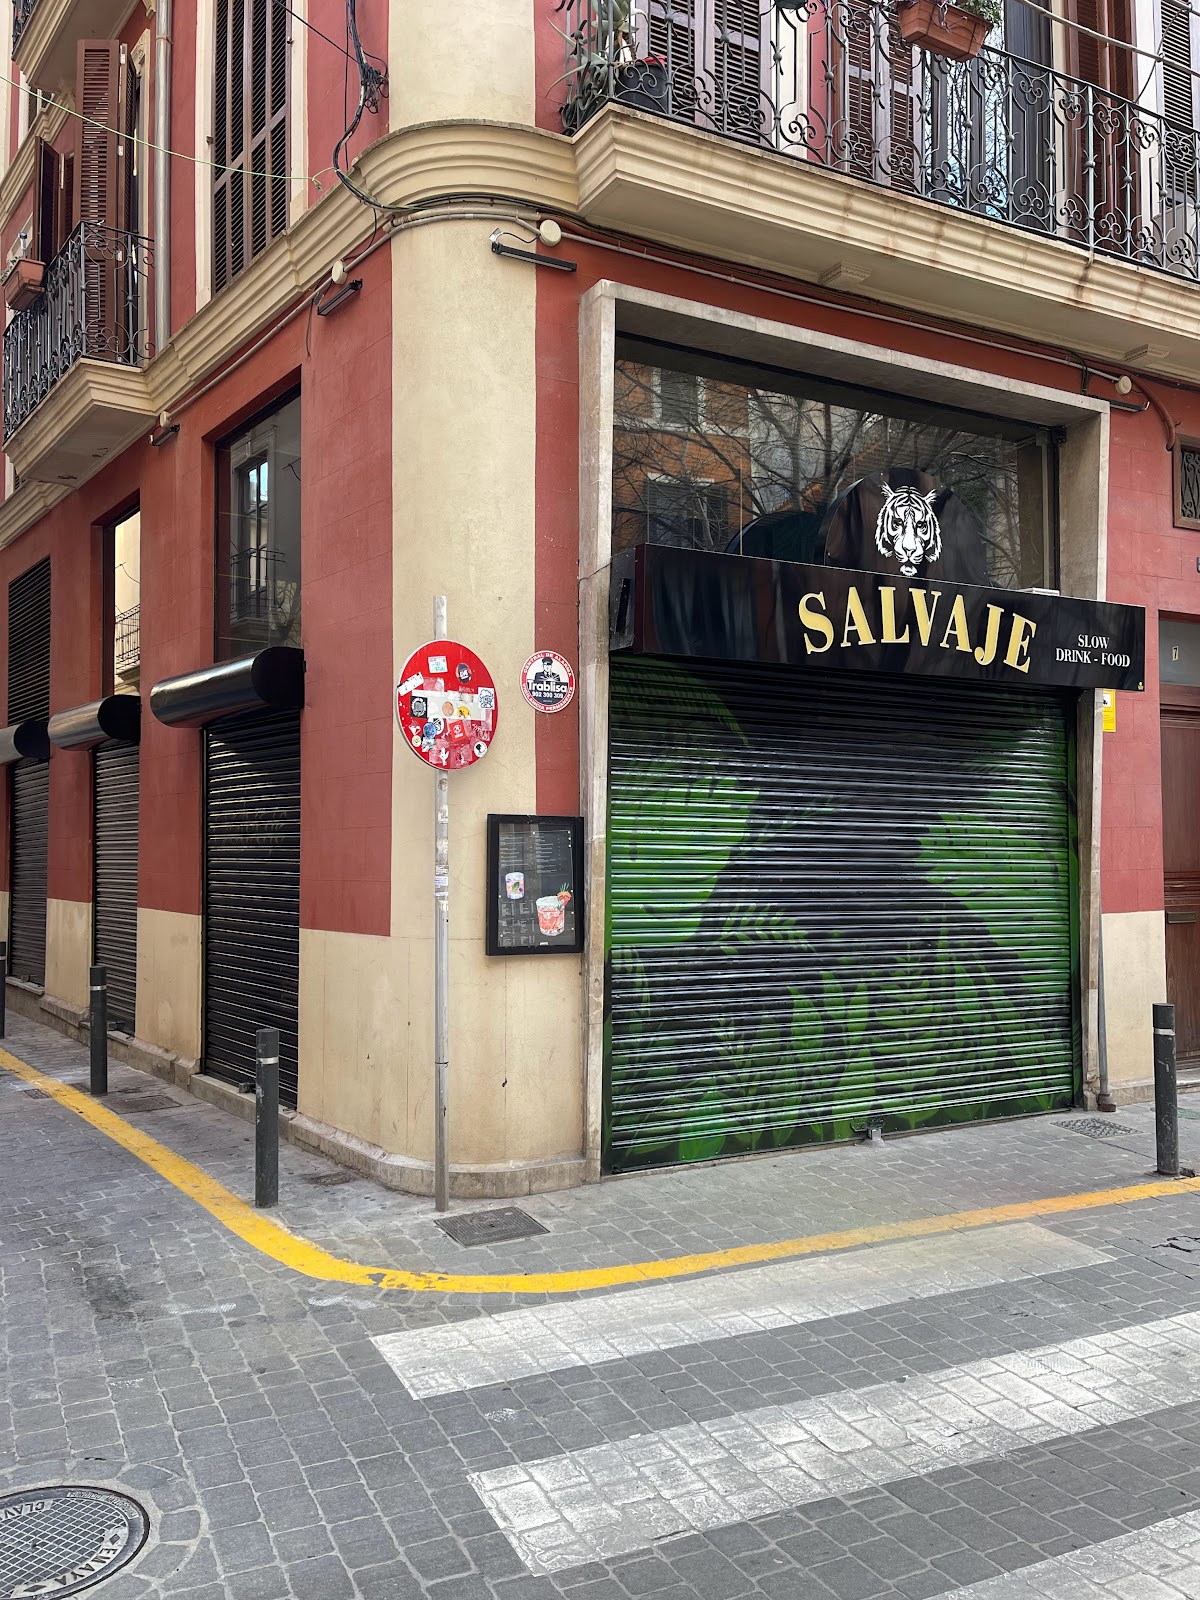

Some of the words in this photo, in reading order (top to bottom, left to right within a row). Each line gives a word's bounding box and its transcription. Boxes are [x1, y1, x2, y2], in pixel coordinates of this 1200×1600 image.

[798, 586, 1037, 674] SALVAJE
[1077, 634, 1110, 649] SLOW
[523, 653, 545, 674] CENTRAL
[554, 654, 573, 677] ALARMA
[1055, 648, 1092, 664] DRINK
[1101, 652, 1131, 668] FOOD
[522, 683, 545, 710] VIGILANCIA
[545, 686, 573, 711] PERMANENTE
[527, 680, 568, 693] Trablisa
[0, 1501, 45, 1519] CLAV
[54, 1548, 118, 1586] EMAYA
